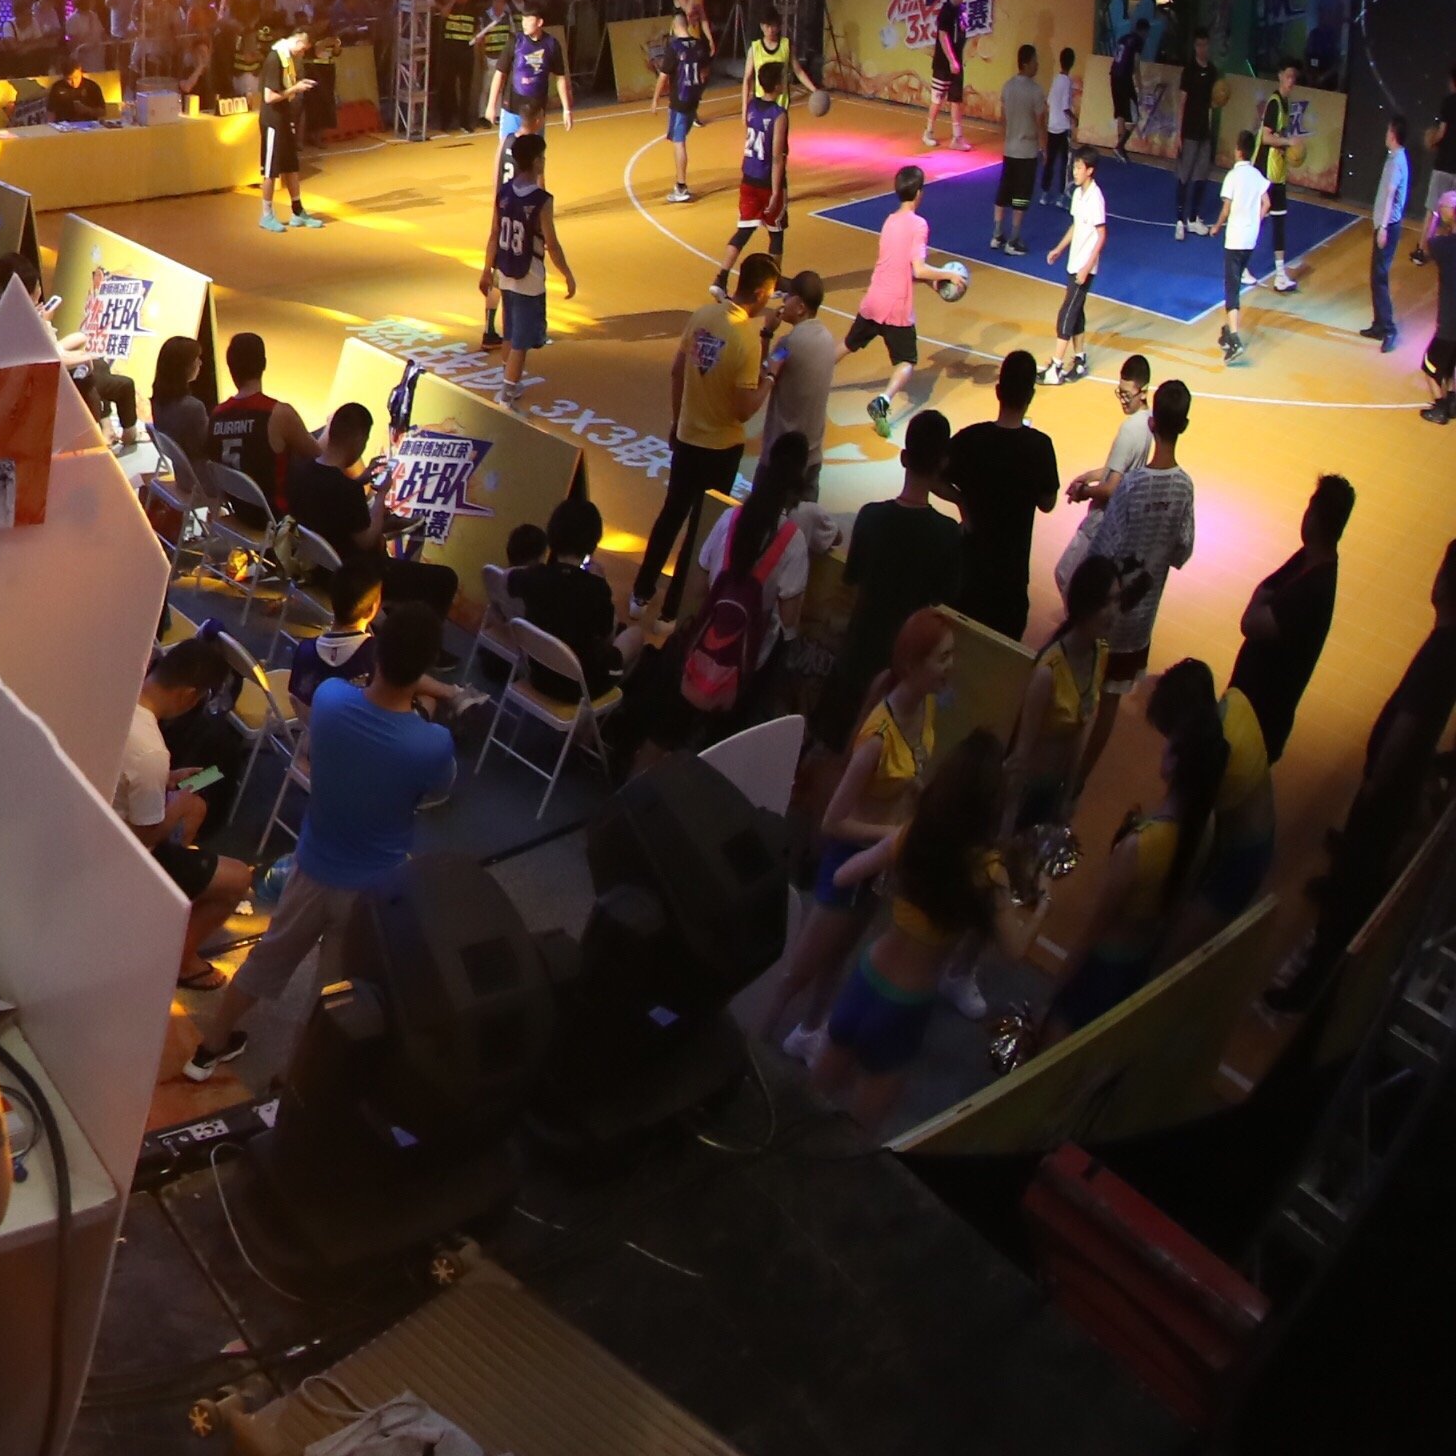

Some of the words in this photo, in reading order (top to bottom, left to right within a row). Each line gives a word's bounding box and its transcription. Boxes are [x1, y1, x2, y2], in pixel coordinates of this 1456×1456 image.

[744, 127, 765, 161] 24
[213, 419, 255, 436] DURANT
[399, 440, 470, 459] 康师傅冰红茶
